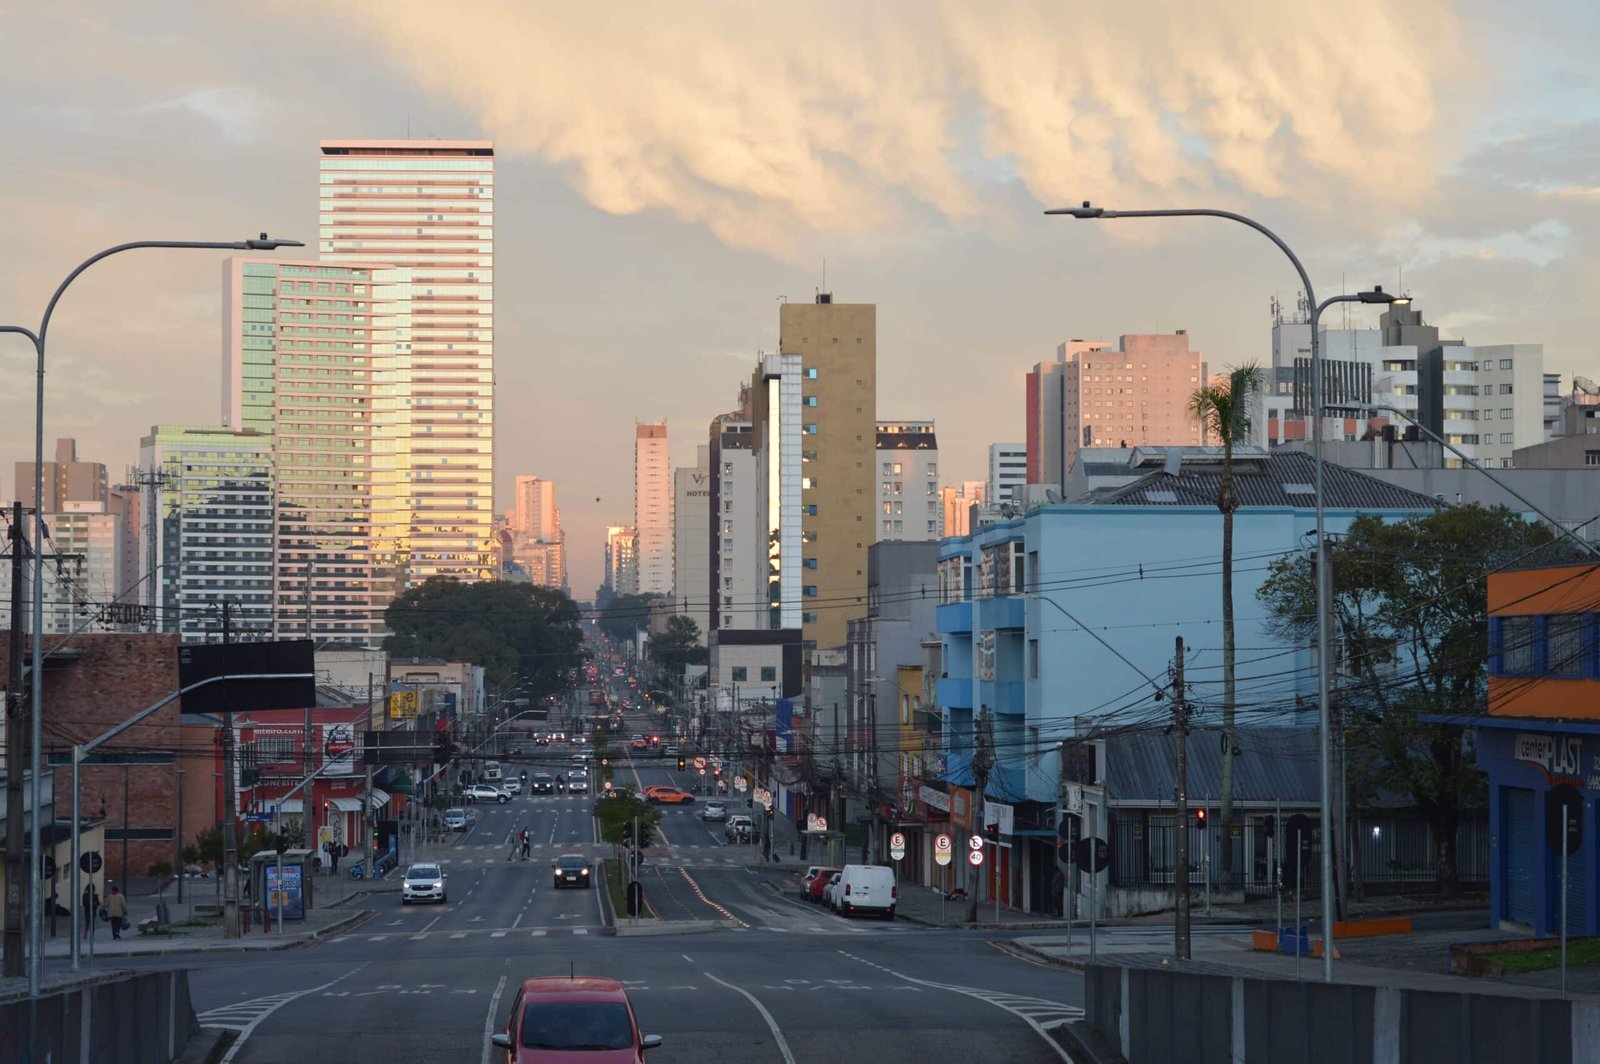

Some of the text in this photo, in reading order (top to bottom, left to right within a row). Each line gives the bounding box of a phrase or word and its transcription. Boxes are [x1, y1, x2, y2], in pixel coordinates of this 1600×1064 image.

[895, 836, 900, 844] E
[940, 838, 946, 847] E
[971, 853, 981, 861] 40
